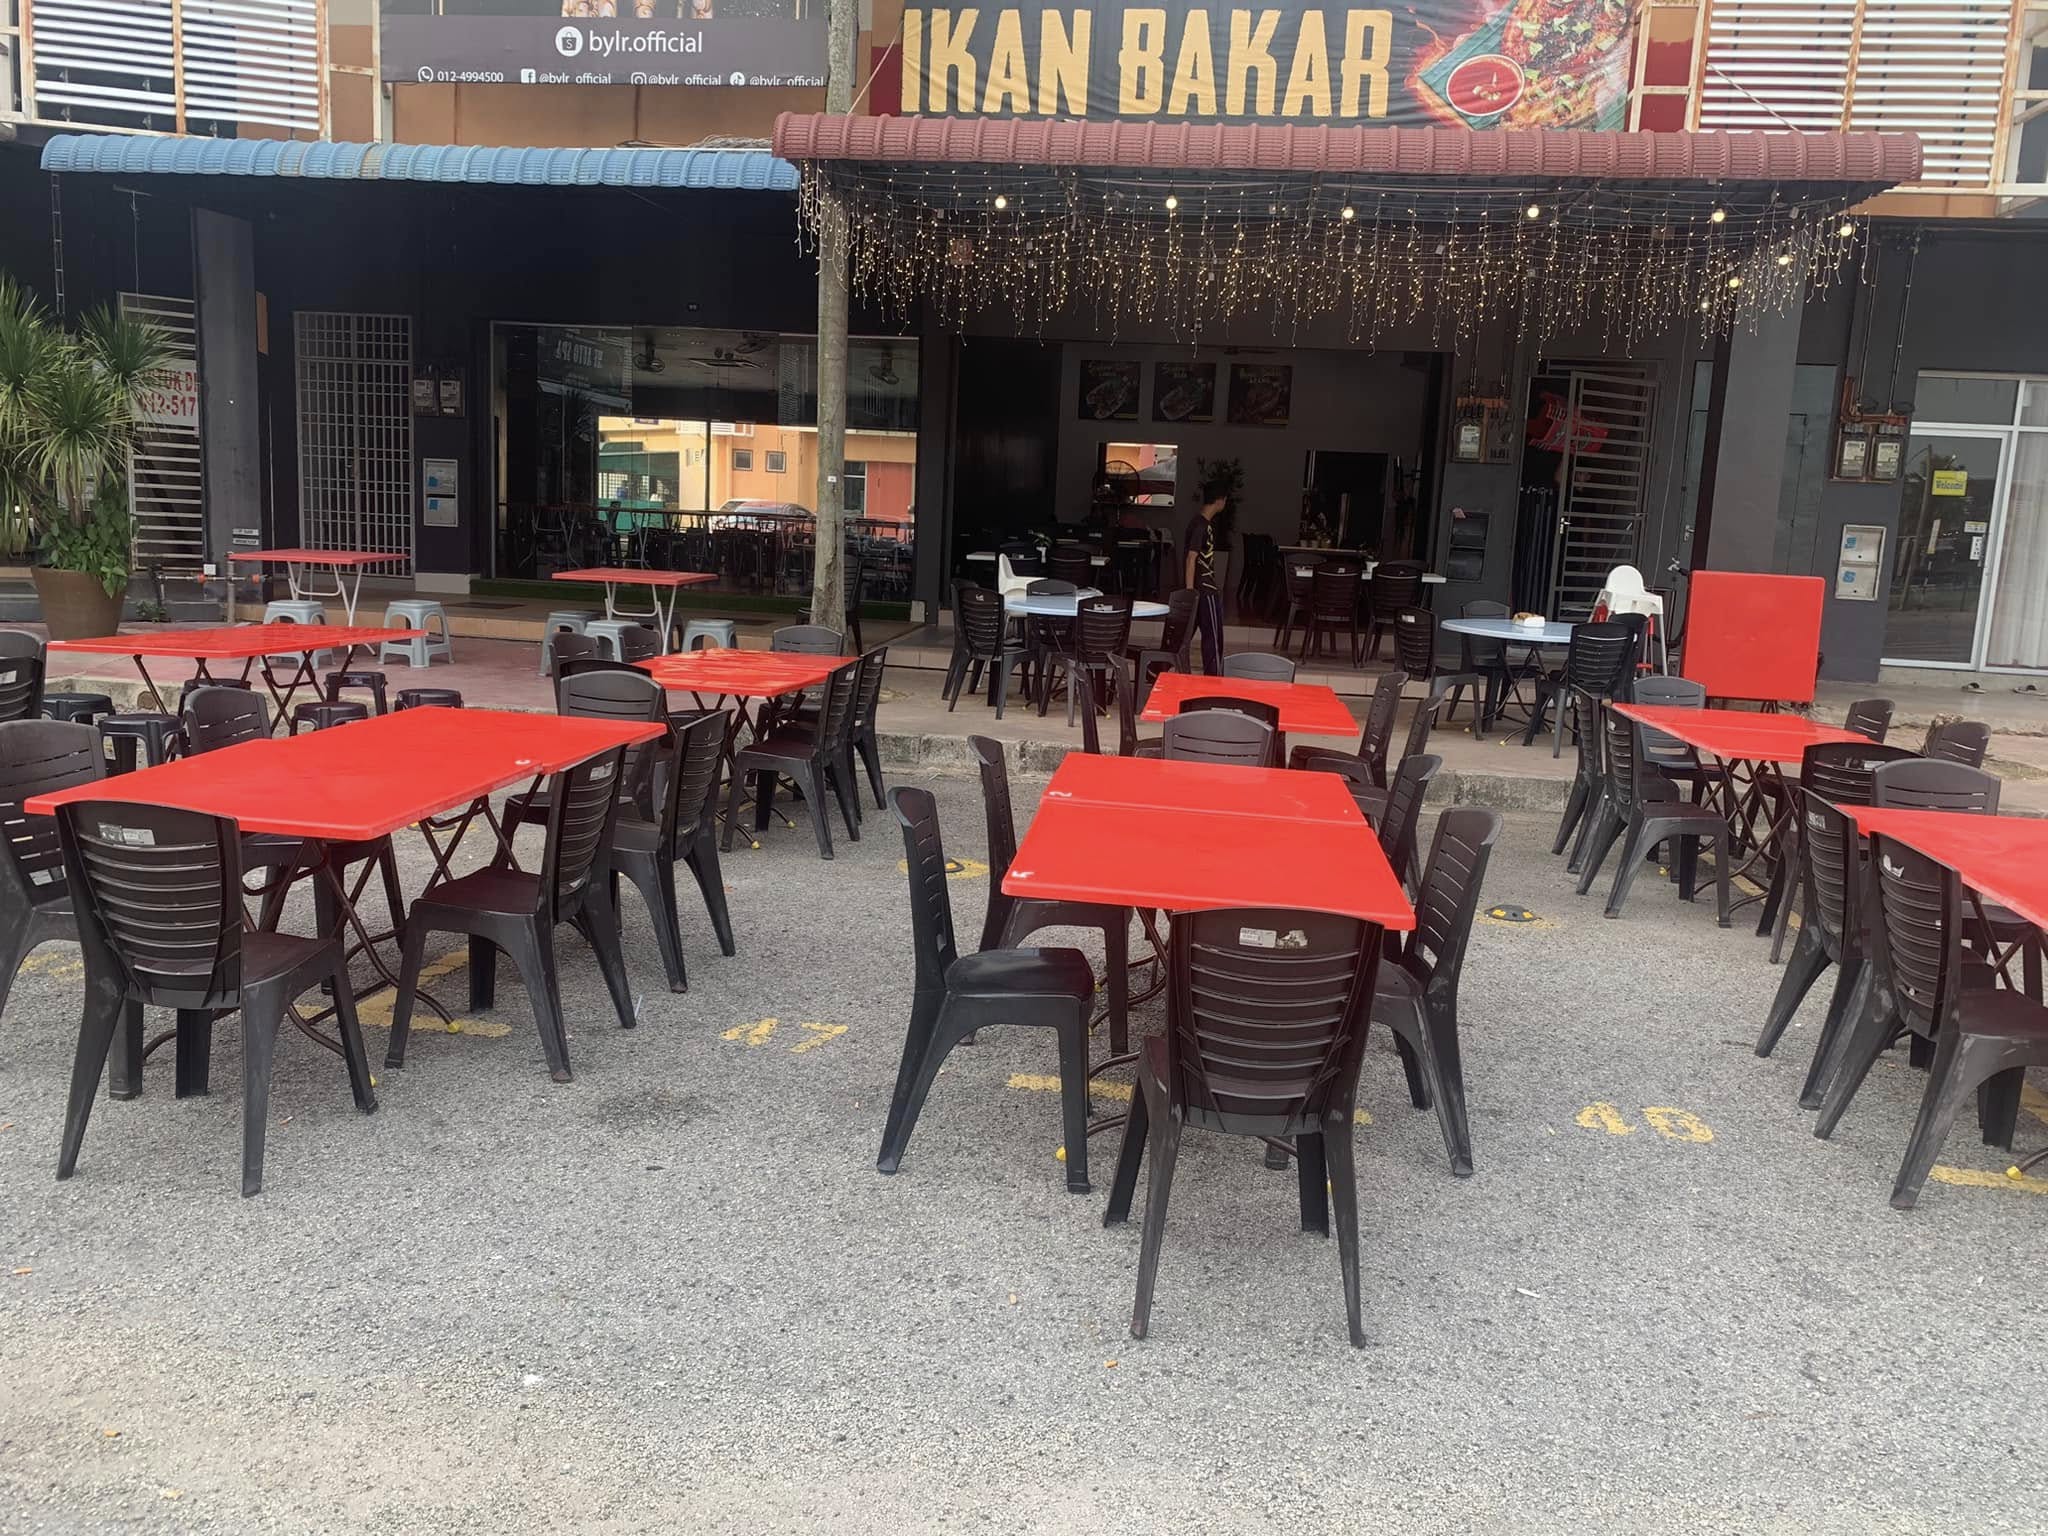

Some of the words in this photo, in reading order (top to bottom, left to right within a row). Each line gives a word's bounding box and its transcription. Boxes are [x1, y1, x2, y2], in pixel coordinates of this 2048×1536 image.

[589, 29, 703, 57] bylr.official
[437, 70, 504, 83] 012-4994500
[901, 9, 1088, 115] IKAN
[1120, 9, 1393, 117] BAKAR
